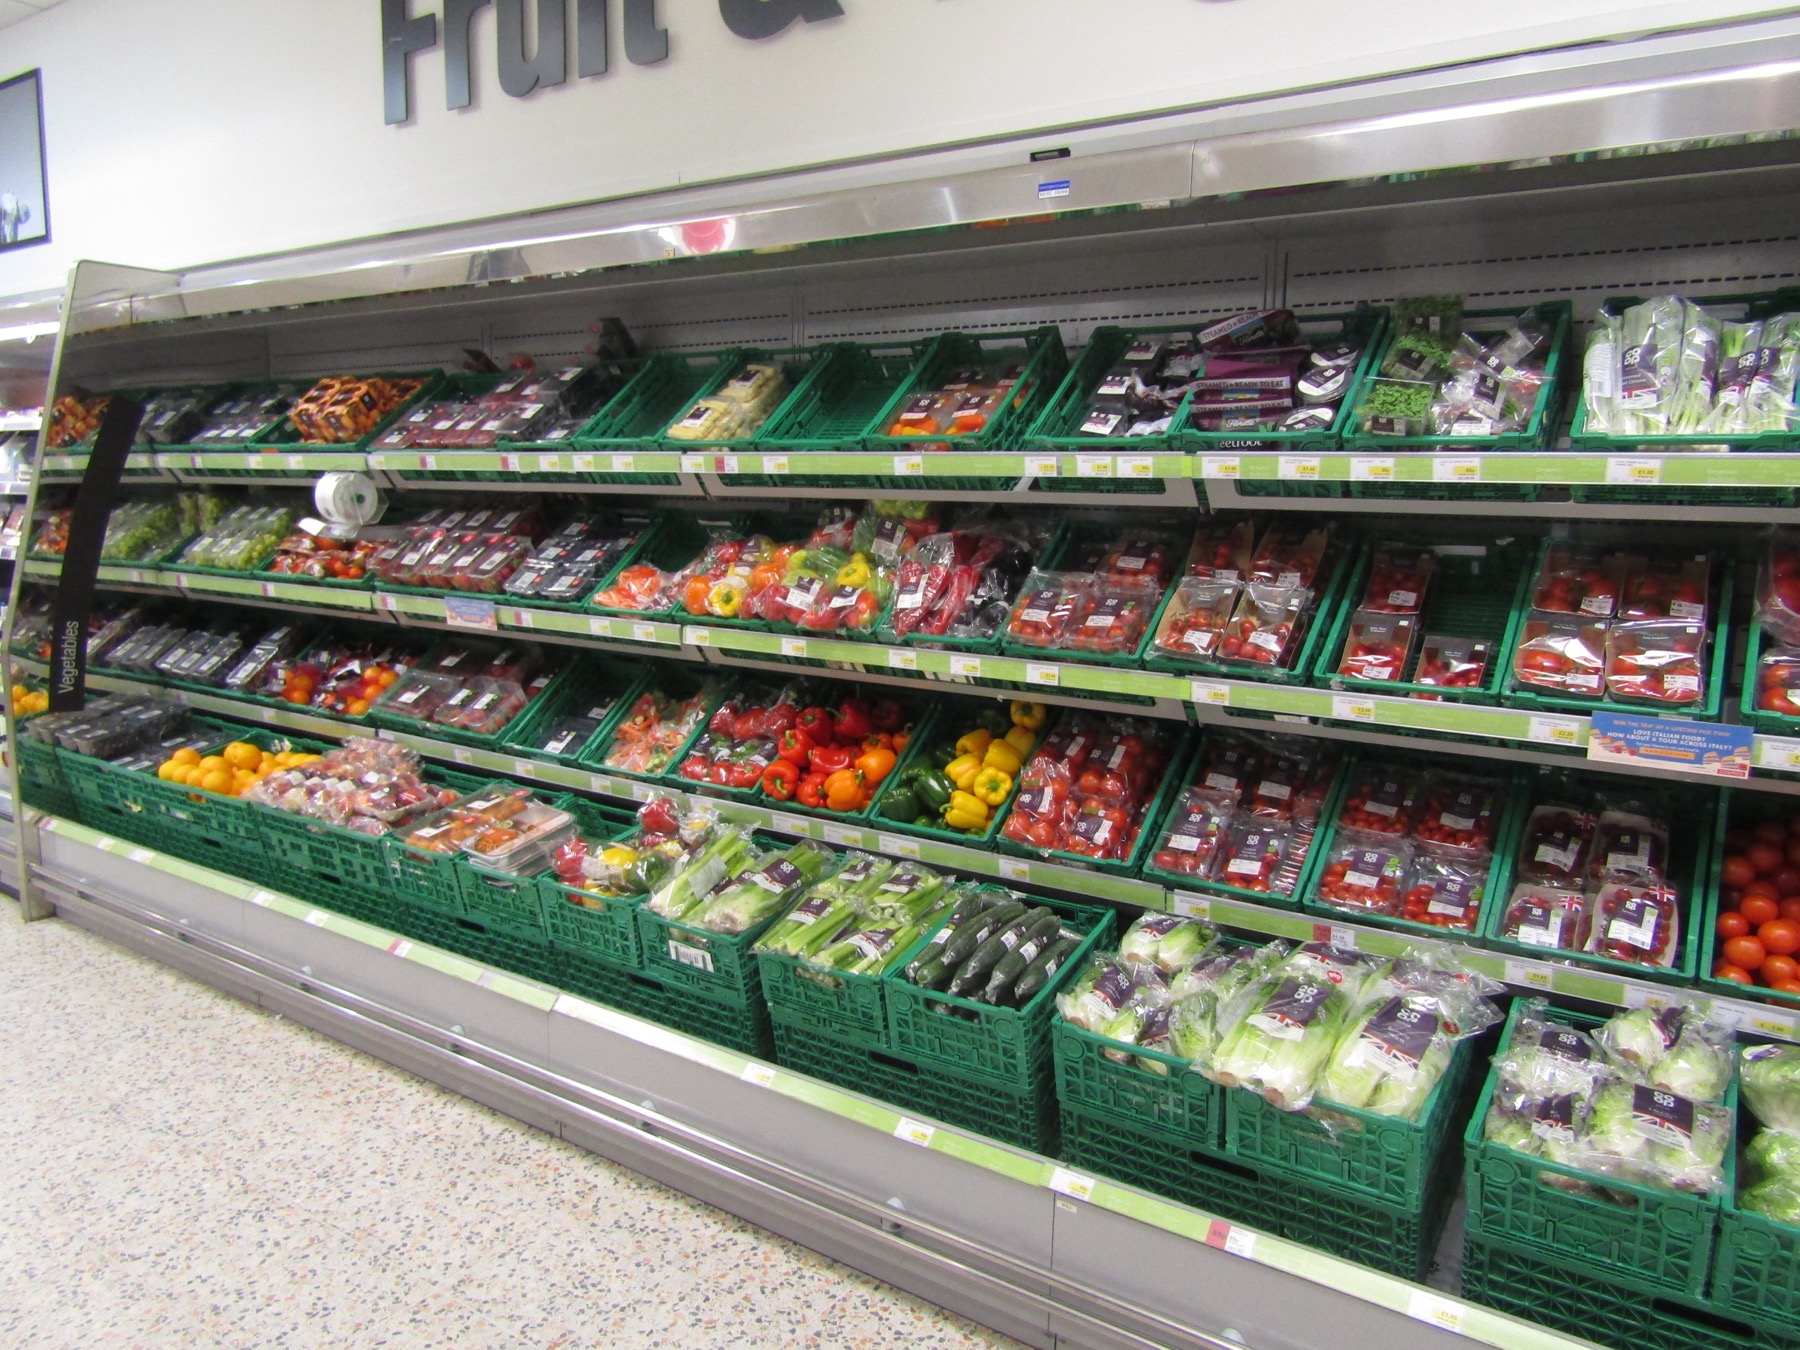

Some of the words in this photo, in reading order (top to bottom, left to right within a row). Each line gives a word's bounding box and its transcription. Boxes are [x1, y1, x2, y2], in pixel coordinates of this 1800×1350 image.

[1203, 323, 1233, 340] STEAMED
[1196, 381, 1229, 389] STEAMED
[1234, 380, 1258, 388] READY
[58, 621, 79, 694] Vegetables
[1652, 731, 1679, 739] ITALIAN
[1679, 739, 1707, 748] ACROSS
[1709, 743, 1733, 751] ITALY?
